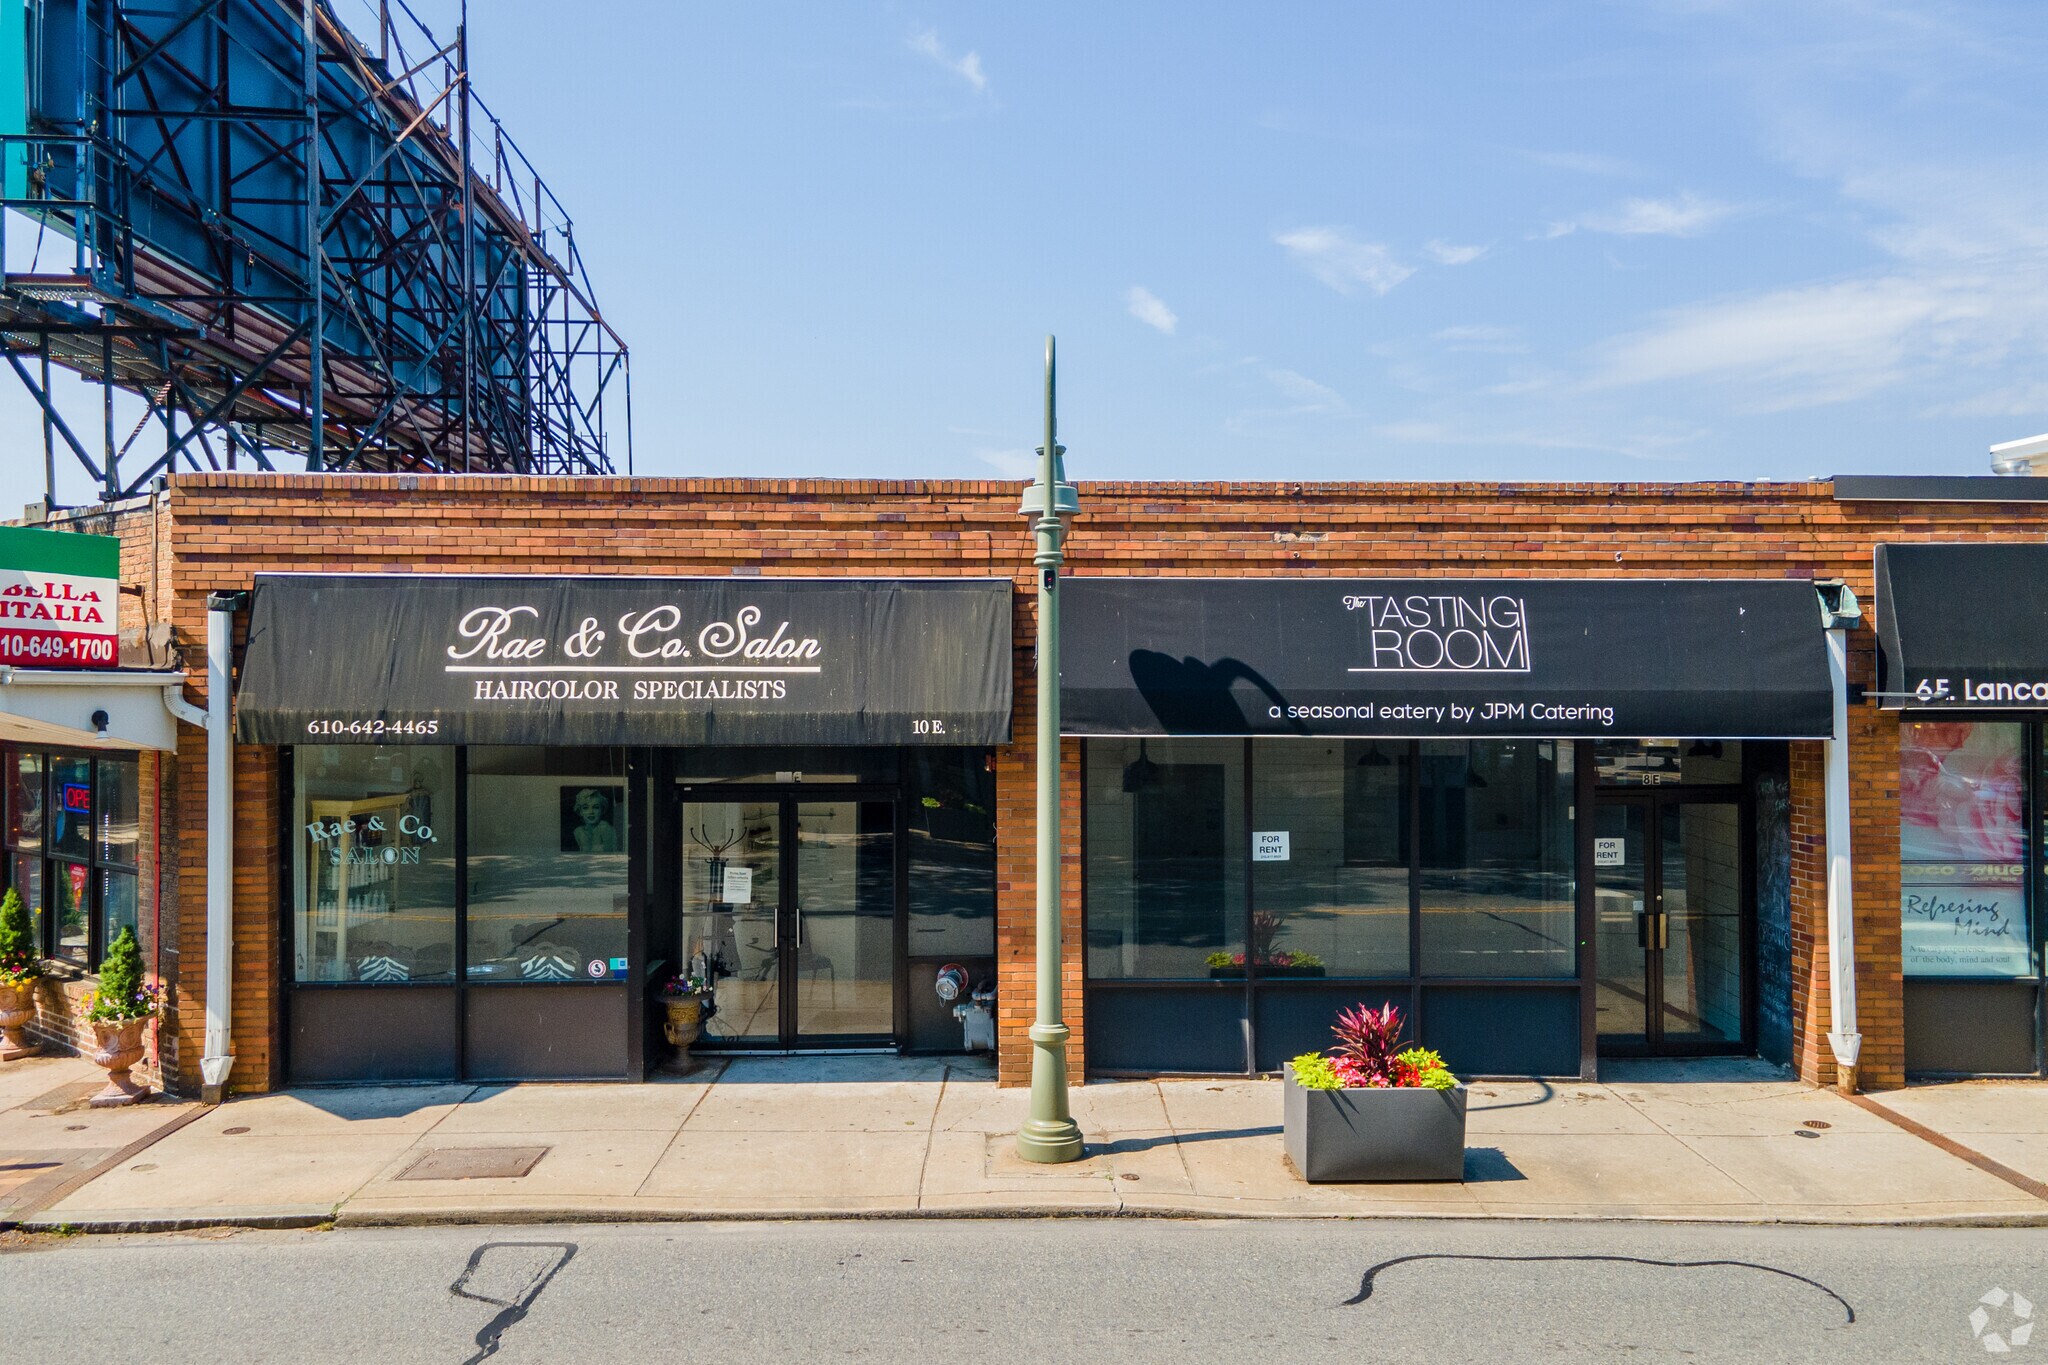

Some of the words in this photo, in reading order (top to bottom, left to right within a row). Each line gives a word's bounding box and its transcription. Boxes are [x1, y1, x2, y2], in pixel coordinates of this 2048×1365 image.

[2, 582, 102, 602] BELLA
[0, 601, 104, 623] ITALIA
[1342, 595, 1366, 611] The
[1358, 595, 1522, 628] TASTING
[447, 605, 546, 659] Rae
[564, 617, 605, 658] &
[618, 605, 691, 658] Co.
[698, 605, 822, 660] Salon
[1371, 629, 1525, 669] ROOM
[474, 680, 619, 700] HAIRCOLOR
[634, 680, 786, 700] SPECIALISTS
[1268, 706, 1282, 719] a
[1287, 702, 1374, 719] seasonal
[1379, 704, 1445, 723] eatery
[1450, 702, 1475, 723] by
[1480, 703, 1525, 720] JPM
[1530, 703, 1615, 726] Catering
[307, 720, 439, 734] 610-642-4465
[305, 820, 357, 843] Rae
[367, 815, 388, 831] &
[398, 814, 438, 843] Co.
[1261, 835, 1280, 843] FOR
[330, 846, 421, 865] SALON
[1596, 851, 1619, 859] RENT
[1907, 894, 1999, 922] Refresing
[1954, 916, 2010, 937] Mind
[1910, 956, 1921, 964] of
[1922, 956, 1935, 964] the
[1959, 955, 1979, 964] mind
[1980, 956, 1994, 964] and
